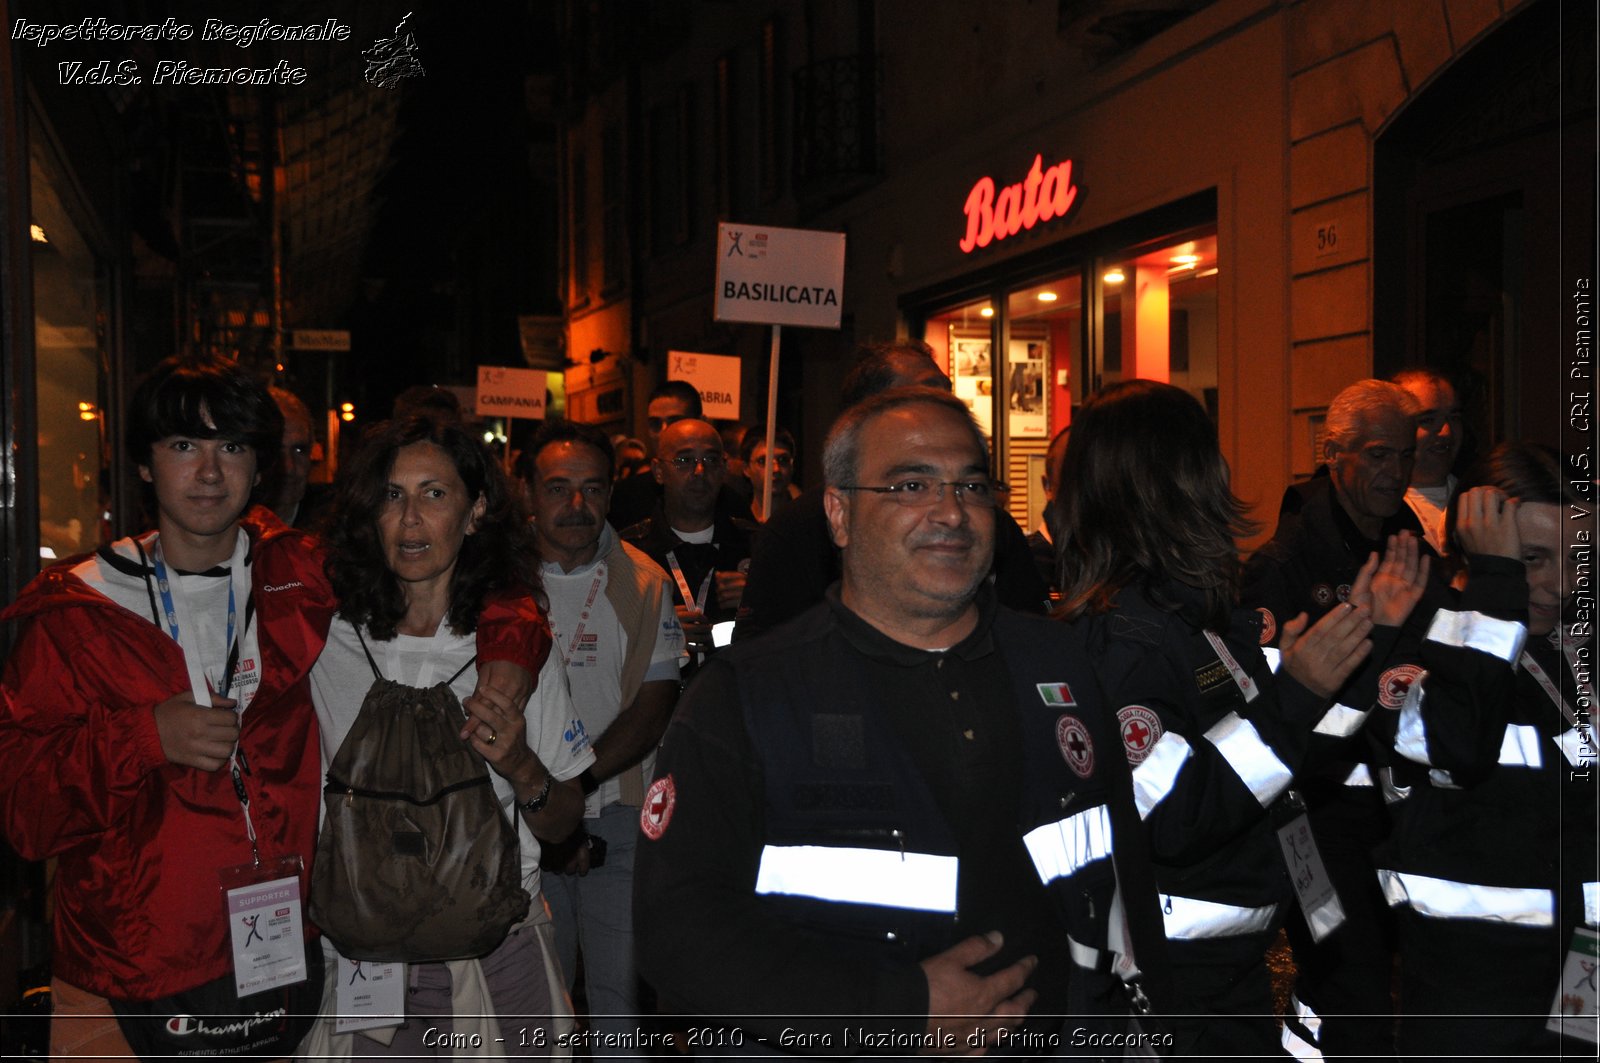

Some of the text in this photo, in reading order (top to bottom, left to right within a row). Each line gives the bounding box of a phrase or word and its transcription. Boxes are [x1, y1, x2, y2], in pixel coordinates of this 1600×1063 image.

[959, 153, 1077, 253] Bata
[1318, 225, 1337, 250] 56
[724, 281, 838, 306] BASILICATA
[481, 395, 542, 408] CAMPANIA
[700, 391, 733, 405] ABRIA
[239, 889, 291, 908] SUPPORTER
[166, 1008, 286, 1037] Champion
[219, 1043, 251, 1055] ATHLETIC
